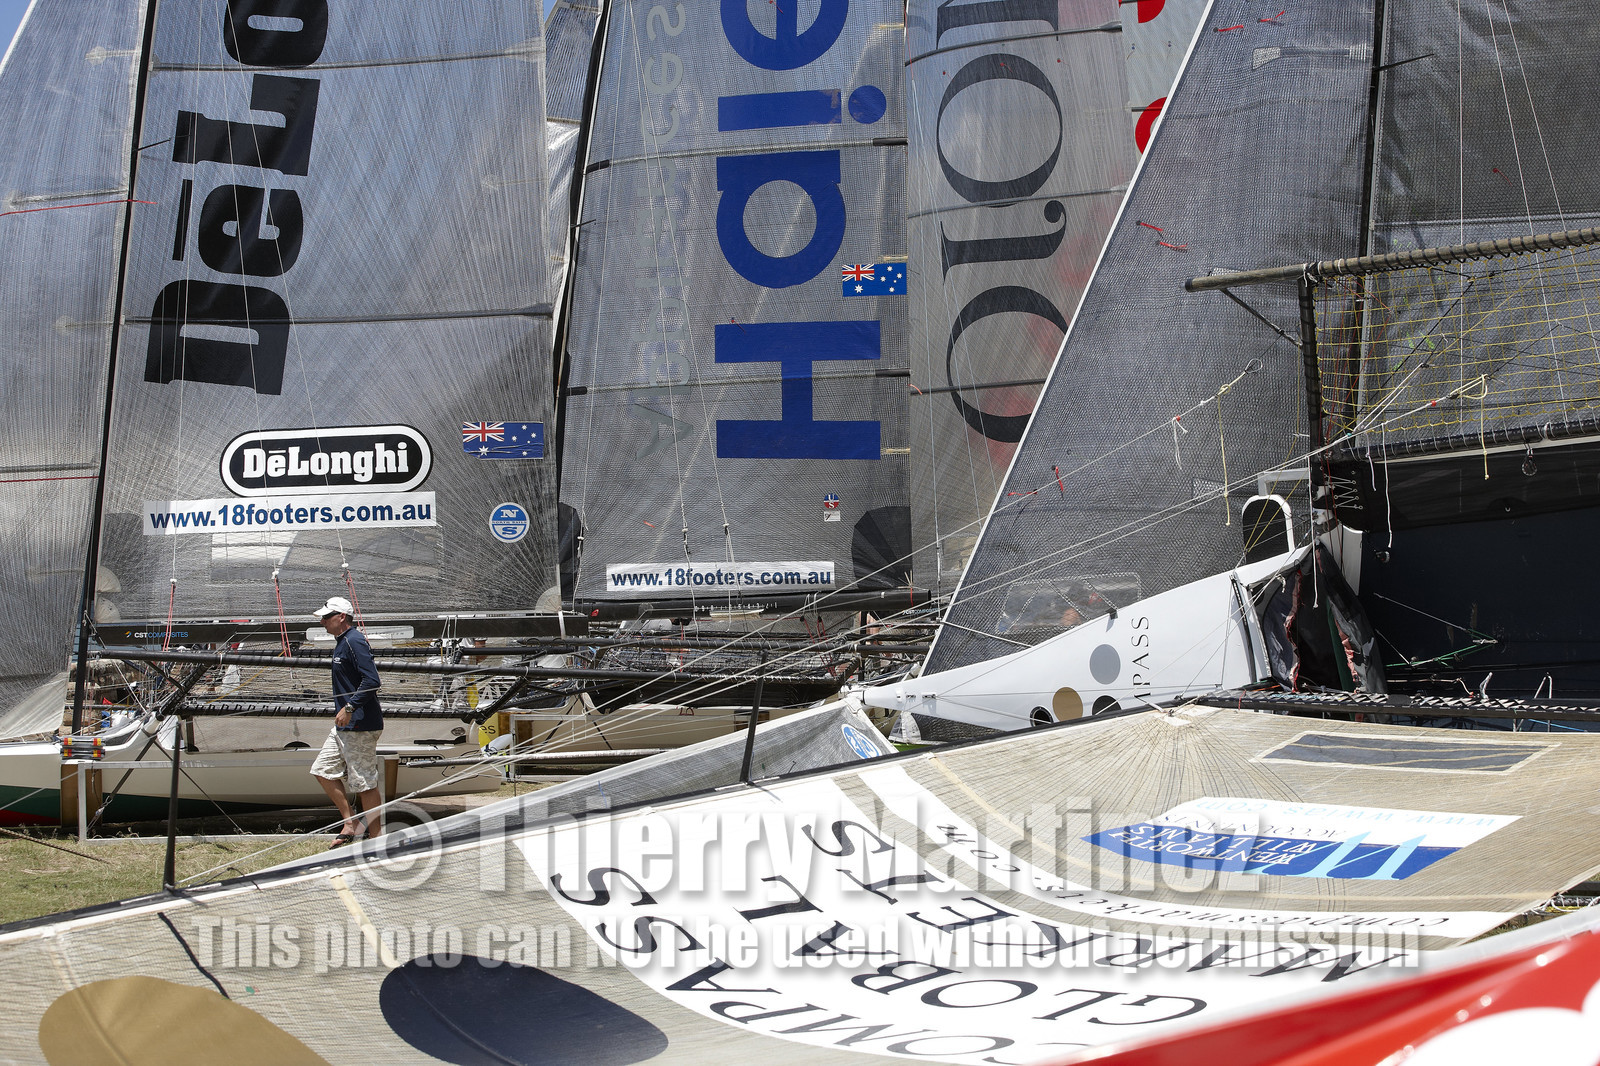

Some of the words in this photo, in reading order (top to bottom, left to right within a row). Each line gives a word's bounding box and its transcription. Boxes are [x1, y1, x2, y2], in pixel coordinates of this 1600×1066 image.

[150, 501, 432, 530] www.18footers.com.au
[500, 509, 519, 518] N
[502, 526, 518, 535] S
[611, 567, 832, 588] www.18footers.com.au
[1109, 829, 1300, 864] WENTWORTH
[1130, 825, 1319, 855] WILLIAMS
[800, 818, 1409, 983] MARKETS
[731, 874, 1209, 1028] GLOBAL
